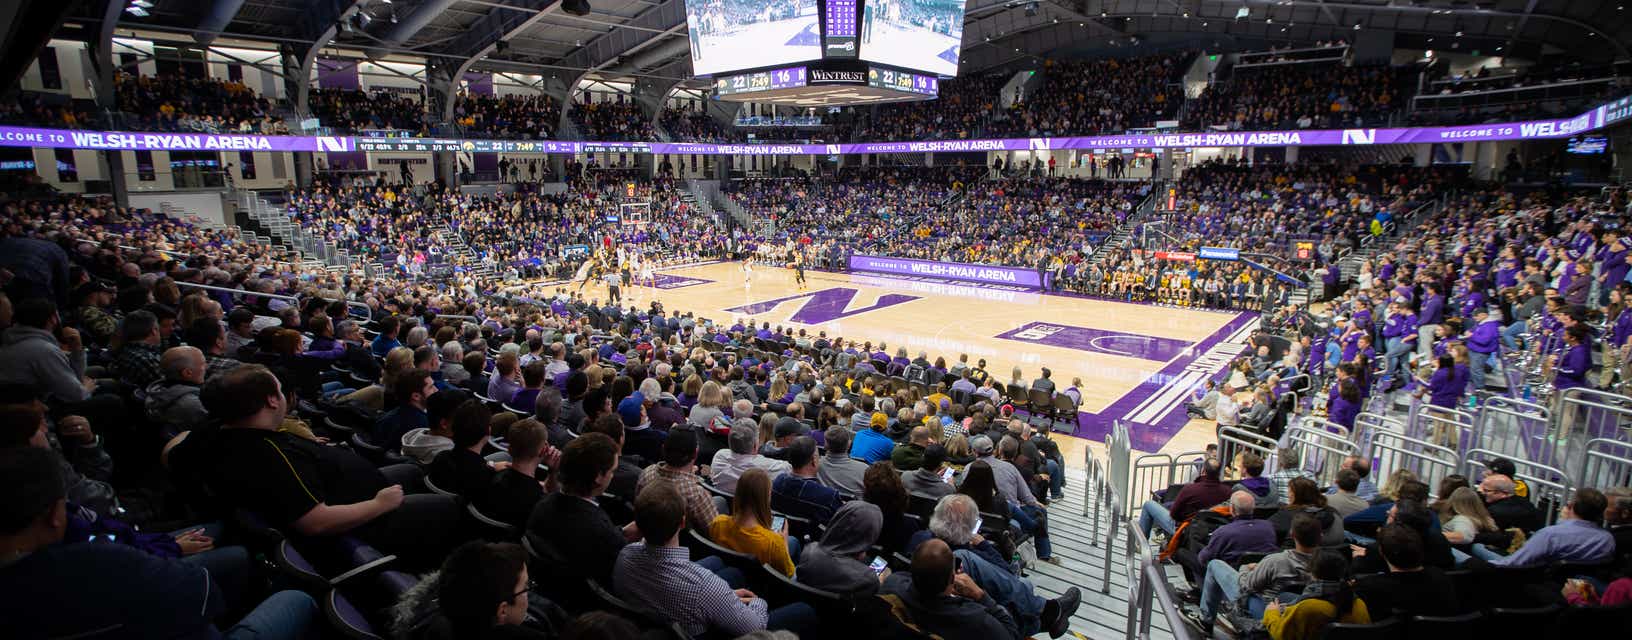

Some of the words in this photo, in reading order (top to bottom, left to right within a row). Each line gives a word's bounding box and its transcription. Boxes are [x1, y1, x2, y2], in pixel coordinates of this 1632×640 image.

[733, 75, 745, 88] 22
[777, 70, 790, 83] 16
[811, 70, 865, 80] WINTRUST
[883, 70, 894, 83] 22
[918, 76, 927, 89] 16
[1090, 138, 1132, 146] WELCOME
[1153, 133, 1244, 147] WELSH-RYAN
[1246, 130, 1302, 145] ARENA
[1440, 127, 1493, 138] WELCOME
[1499, 127, 1513, 136] TO
[49, 134, 65, 143] TO
[71, 132, 201, 149] WELSH-RYAN
[205, 136, 272, 149] ARENA
[492, 142, 503, 150] 22
[516, 142, 534, 151] 7:49
[548, 143, 557, 151] 16
[909, 142, 969, 152] WELSH-RYAN
[970, 139, 1005, 151] ARENA
[717, 144, 769, 154] WELSH-RYAN
[771, 145, 804, 154] ARENA
[911, 262, 976, 277] WELSH-RYAN
[977, 268, 1017, 281] ARENA
